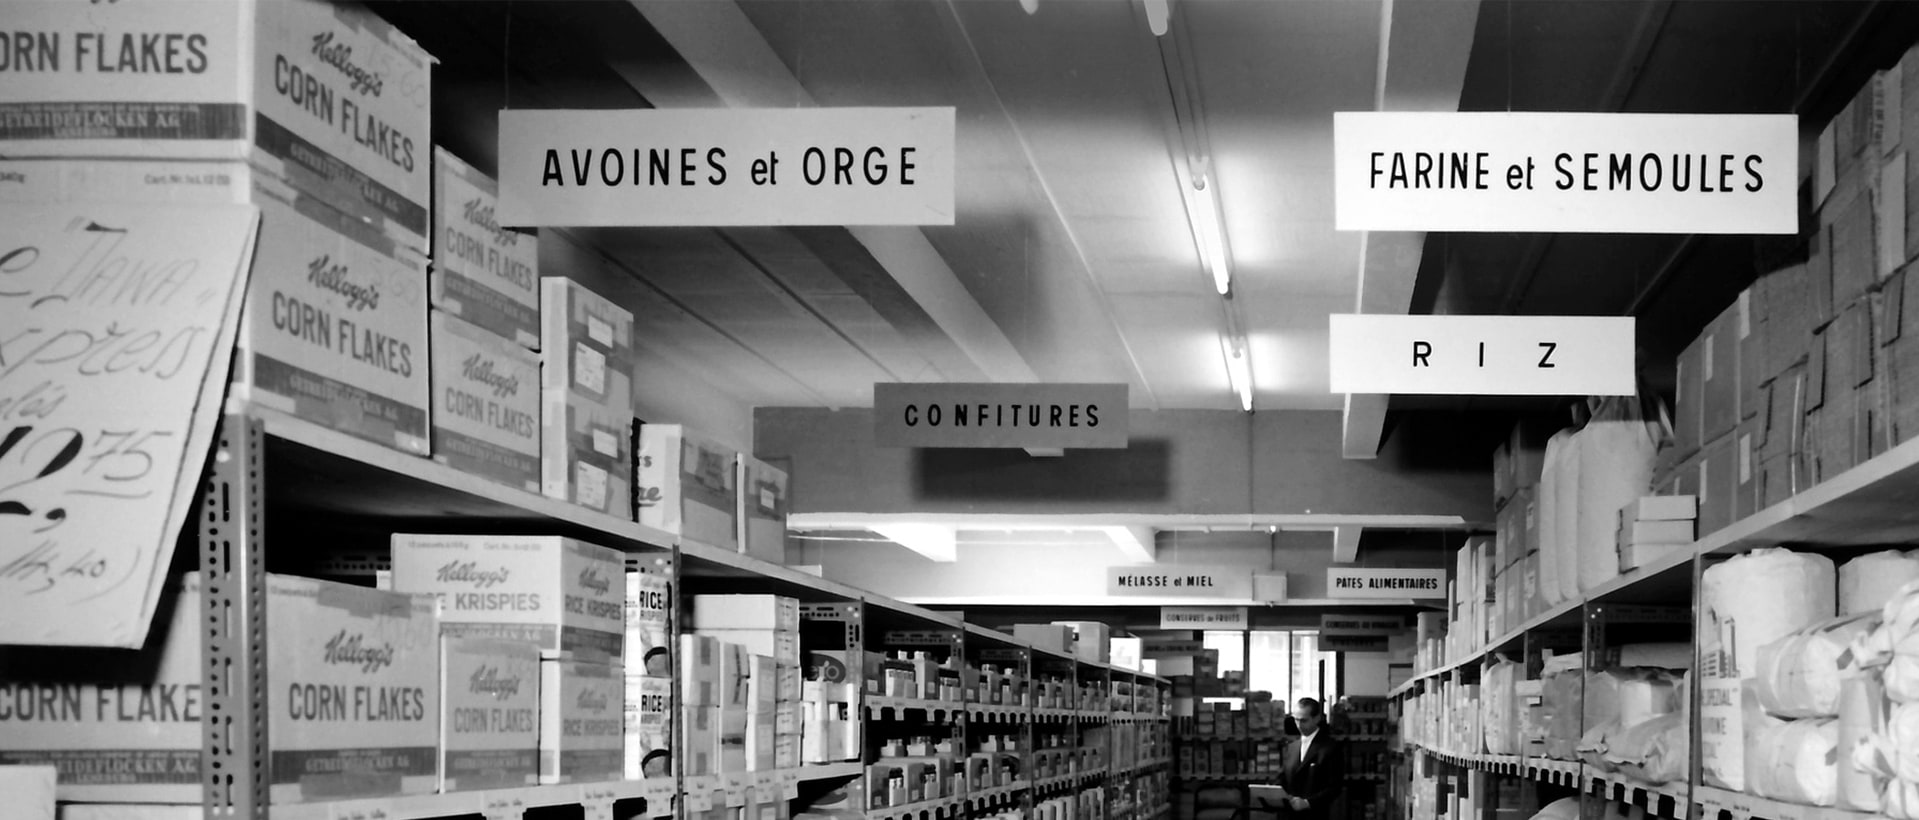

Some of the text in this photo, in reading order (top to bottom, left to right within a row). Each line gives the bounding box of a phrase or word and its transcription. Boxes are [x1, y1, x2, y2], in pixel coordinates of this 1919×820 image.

[75, 32, 208, 74] FLAKES
[311, 31, 383, 97] Kellogg's
[275, 53, 334, 126] CORN
[341, 97, 414, 173] FLAKES
[541, 147, 917, 187] AVOINES et ORGE
[1369, 152, 1764, 193] FARINE et SEMOULES
[446, 226, 533, 292] CORN FLAKES
[308, 253, 380, 312] Kellogg's
[272, 290, 412, 379] CORN FLAKES
[446, 387, 535, 439] CORN FLAKES
[904, 404, 1101, 428] CONFITURES
[436, 560, 509, 587] Kellogg's
[1118, 572, 1213, 587] MÉLASSE et MIEL
[1336, 577, 1438, 589] PATES ALIMENTAIRES
[455, 593, 541, 611] KRISPIES
[640, 591, 663, 610] RICE
[1215, 613, 1240, 623] FRUITS
[324, 629, 394, 674] Kellogg's
[289, 683, 424, 721] CORN FLAKES
[454, 707, 532, 733] CORN FLAKES
[641, 695, 662, 712] RICE
